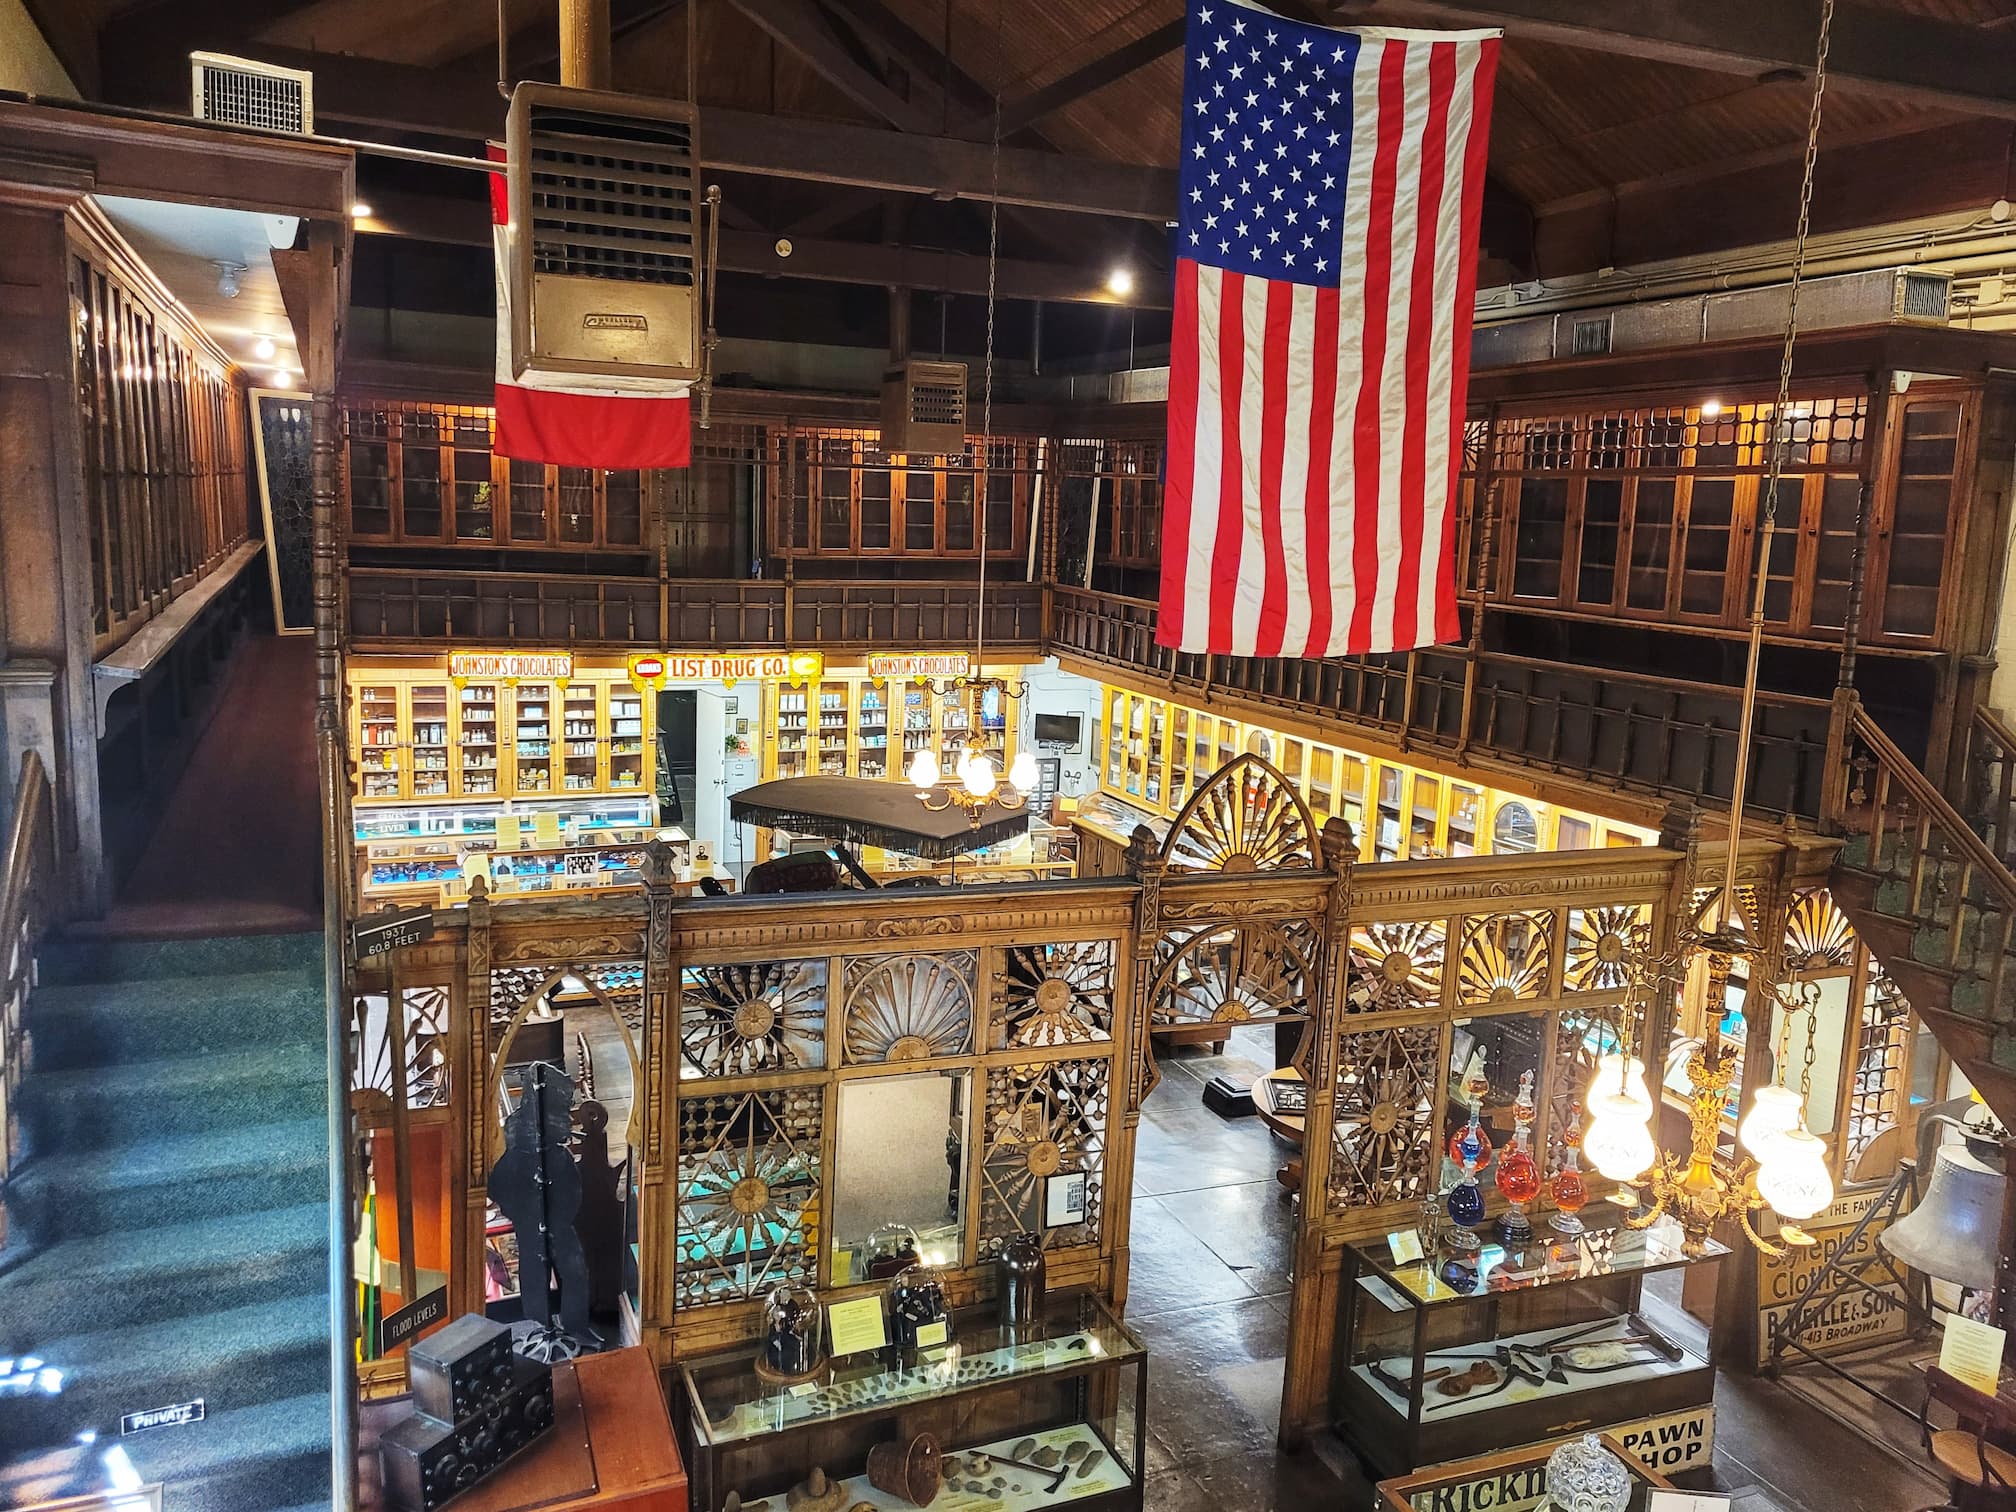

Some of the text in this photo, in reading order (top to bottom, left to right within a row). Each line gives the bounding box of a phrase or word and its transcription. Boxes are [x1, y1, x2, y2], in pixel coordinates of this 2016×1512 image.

[452, 656, 568, 676] JOHNSTON'S CHOCOLATES
[672, 658, 786, 677] LIST DRUG CO.
[873, 657, 966, 675] JOHNSTON'S CHOCOLATES
[369, 932, 421, 955] 60.8 FEET
[381, 926, 406, 940] 1937
[1830, 1202, 1848, 1217] THE
[1861, 1290, 1896, 1319] SON
[392, 1302, 437, 1339] FLOOD LEVELS
[1825, 1316, 1888, 1341] BROADWAY
[132, 1405, 192, 1429] PRIVATE
[1623, 1418, 1704, 1450] PAWN
[1640, 1442, 1702, 1469] HOP
